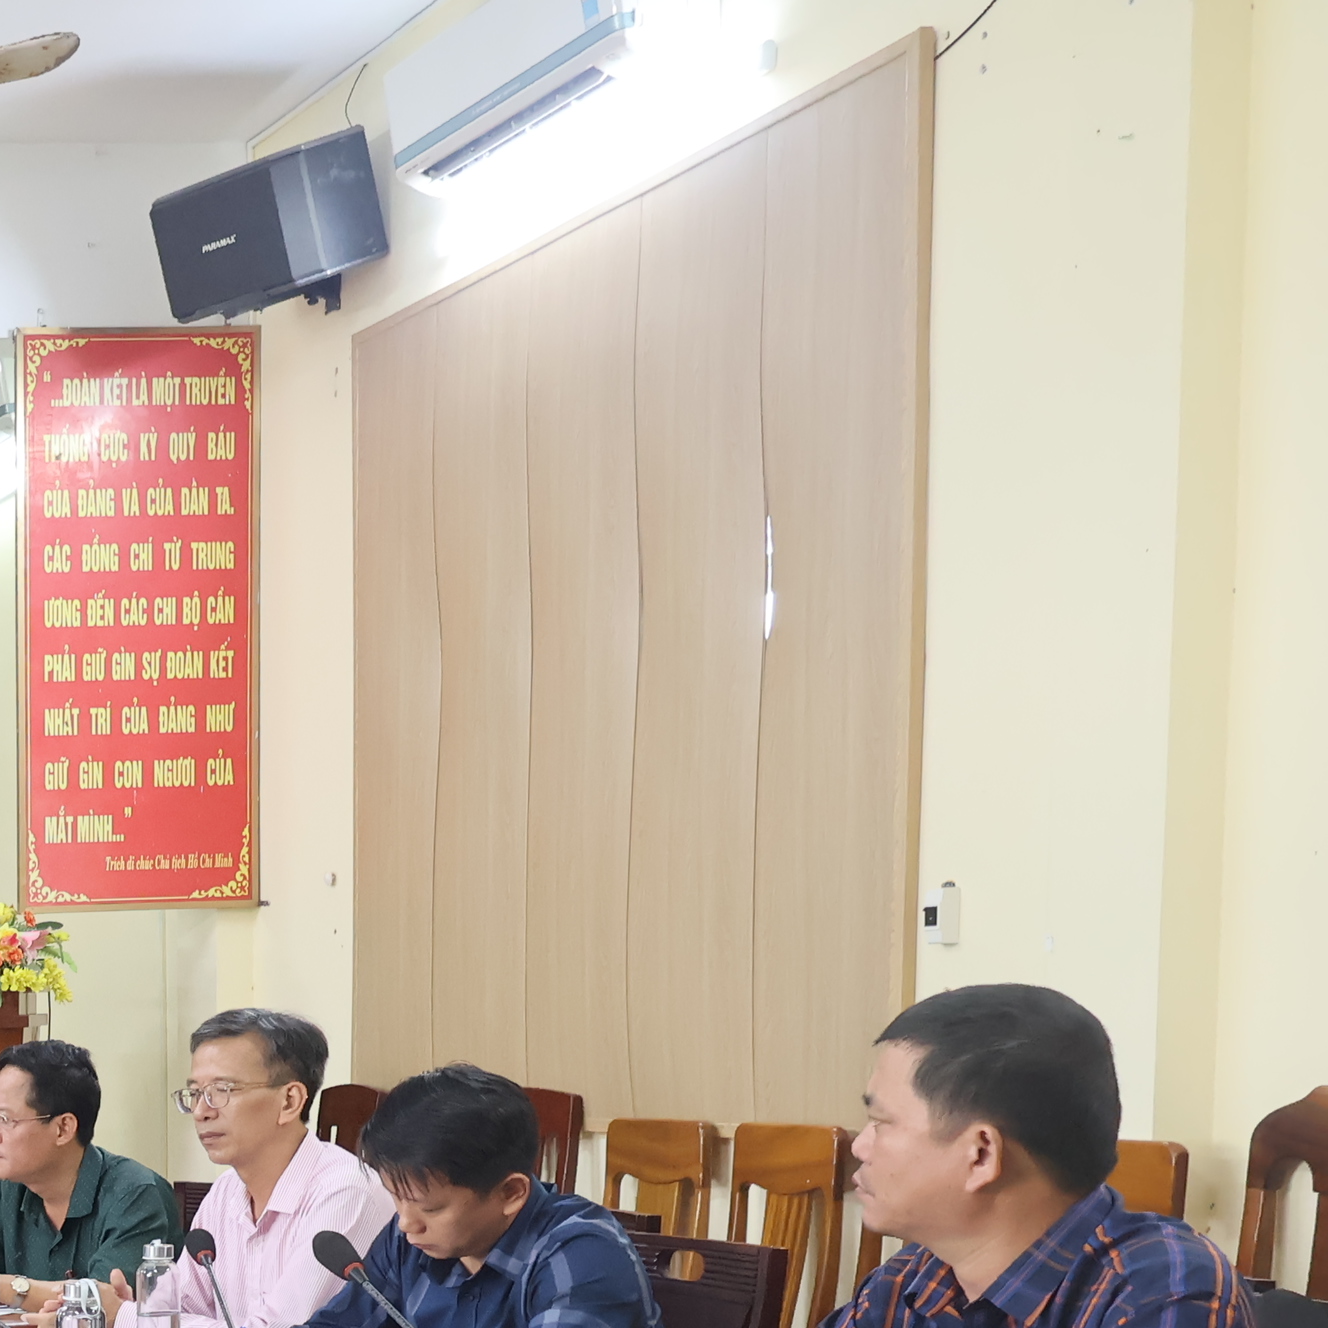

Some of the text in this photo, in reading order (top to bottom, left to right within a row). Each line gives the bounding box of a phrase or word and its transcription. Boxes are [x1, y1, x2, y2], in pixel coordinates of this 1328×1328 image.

[202, 233, 237, 253] PARAMAX
[104, 367, 236, 412] KẾT LÀ MỘT TRUYỀN
[43, 424, 235, 468] THỐNG CỰC KỲ QUÝ BÁU
[44, 478, 234, 518] CỦA ĐẢNG VÀ CỦA DÂN TA.
[44, 534, 234, 573] CÁC ĐỒNG CHÍ TỪ TRUNG
[44, 586, 234, 631] ƯƠNG ĐẾN CÁC CHI BỘ CẦN
[44, 641, 234, 686] PHẢI GIỮ GÌN SỰ ĐOÀN KẾT
[44, 696, 235, 736] NHẤT TRÍ CỦA ĐẢNG NHƯ
[44, 756, 69, 790] GIỮ
[79, 755, 103, 790] GÌN
[114, 760, 142, 788] CON
[206, 749, 234, 786] CỦA
[45, 806, 74, 844] MẮT
[105, 856, 125, 871] Trích
[126, 855, 135, 870] di
[136, 854, 154, 870] chúc
[172, 854, 186, 872] tịch
[188, 852, 198, 868] Hồ
[200, 853, 213, 868] Chí
[214, 852, 233, 868] Minh
